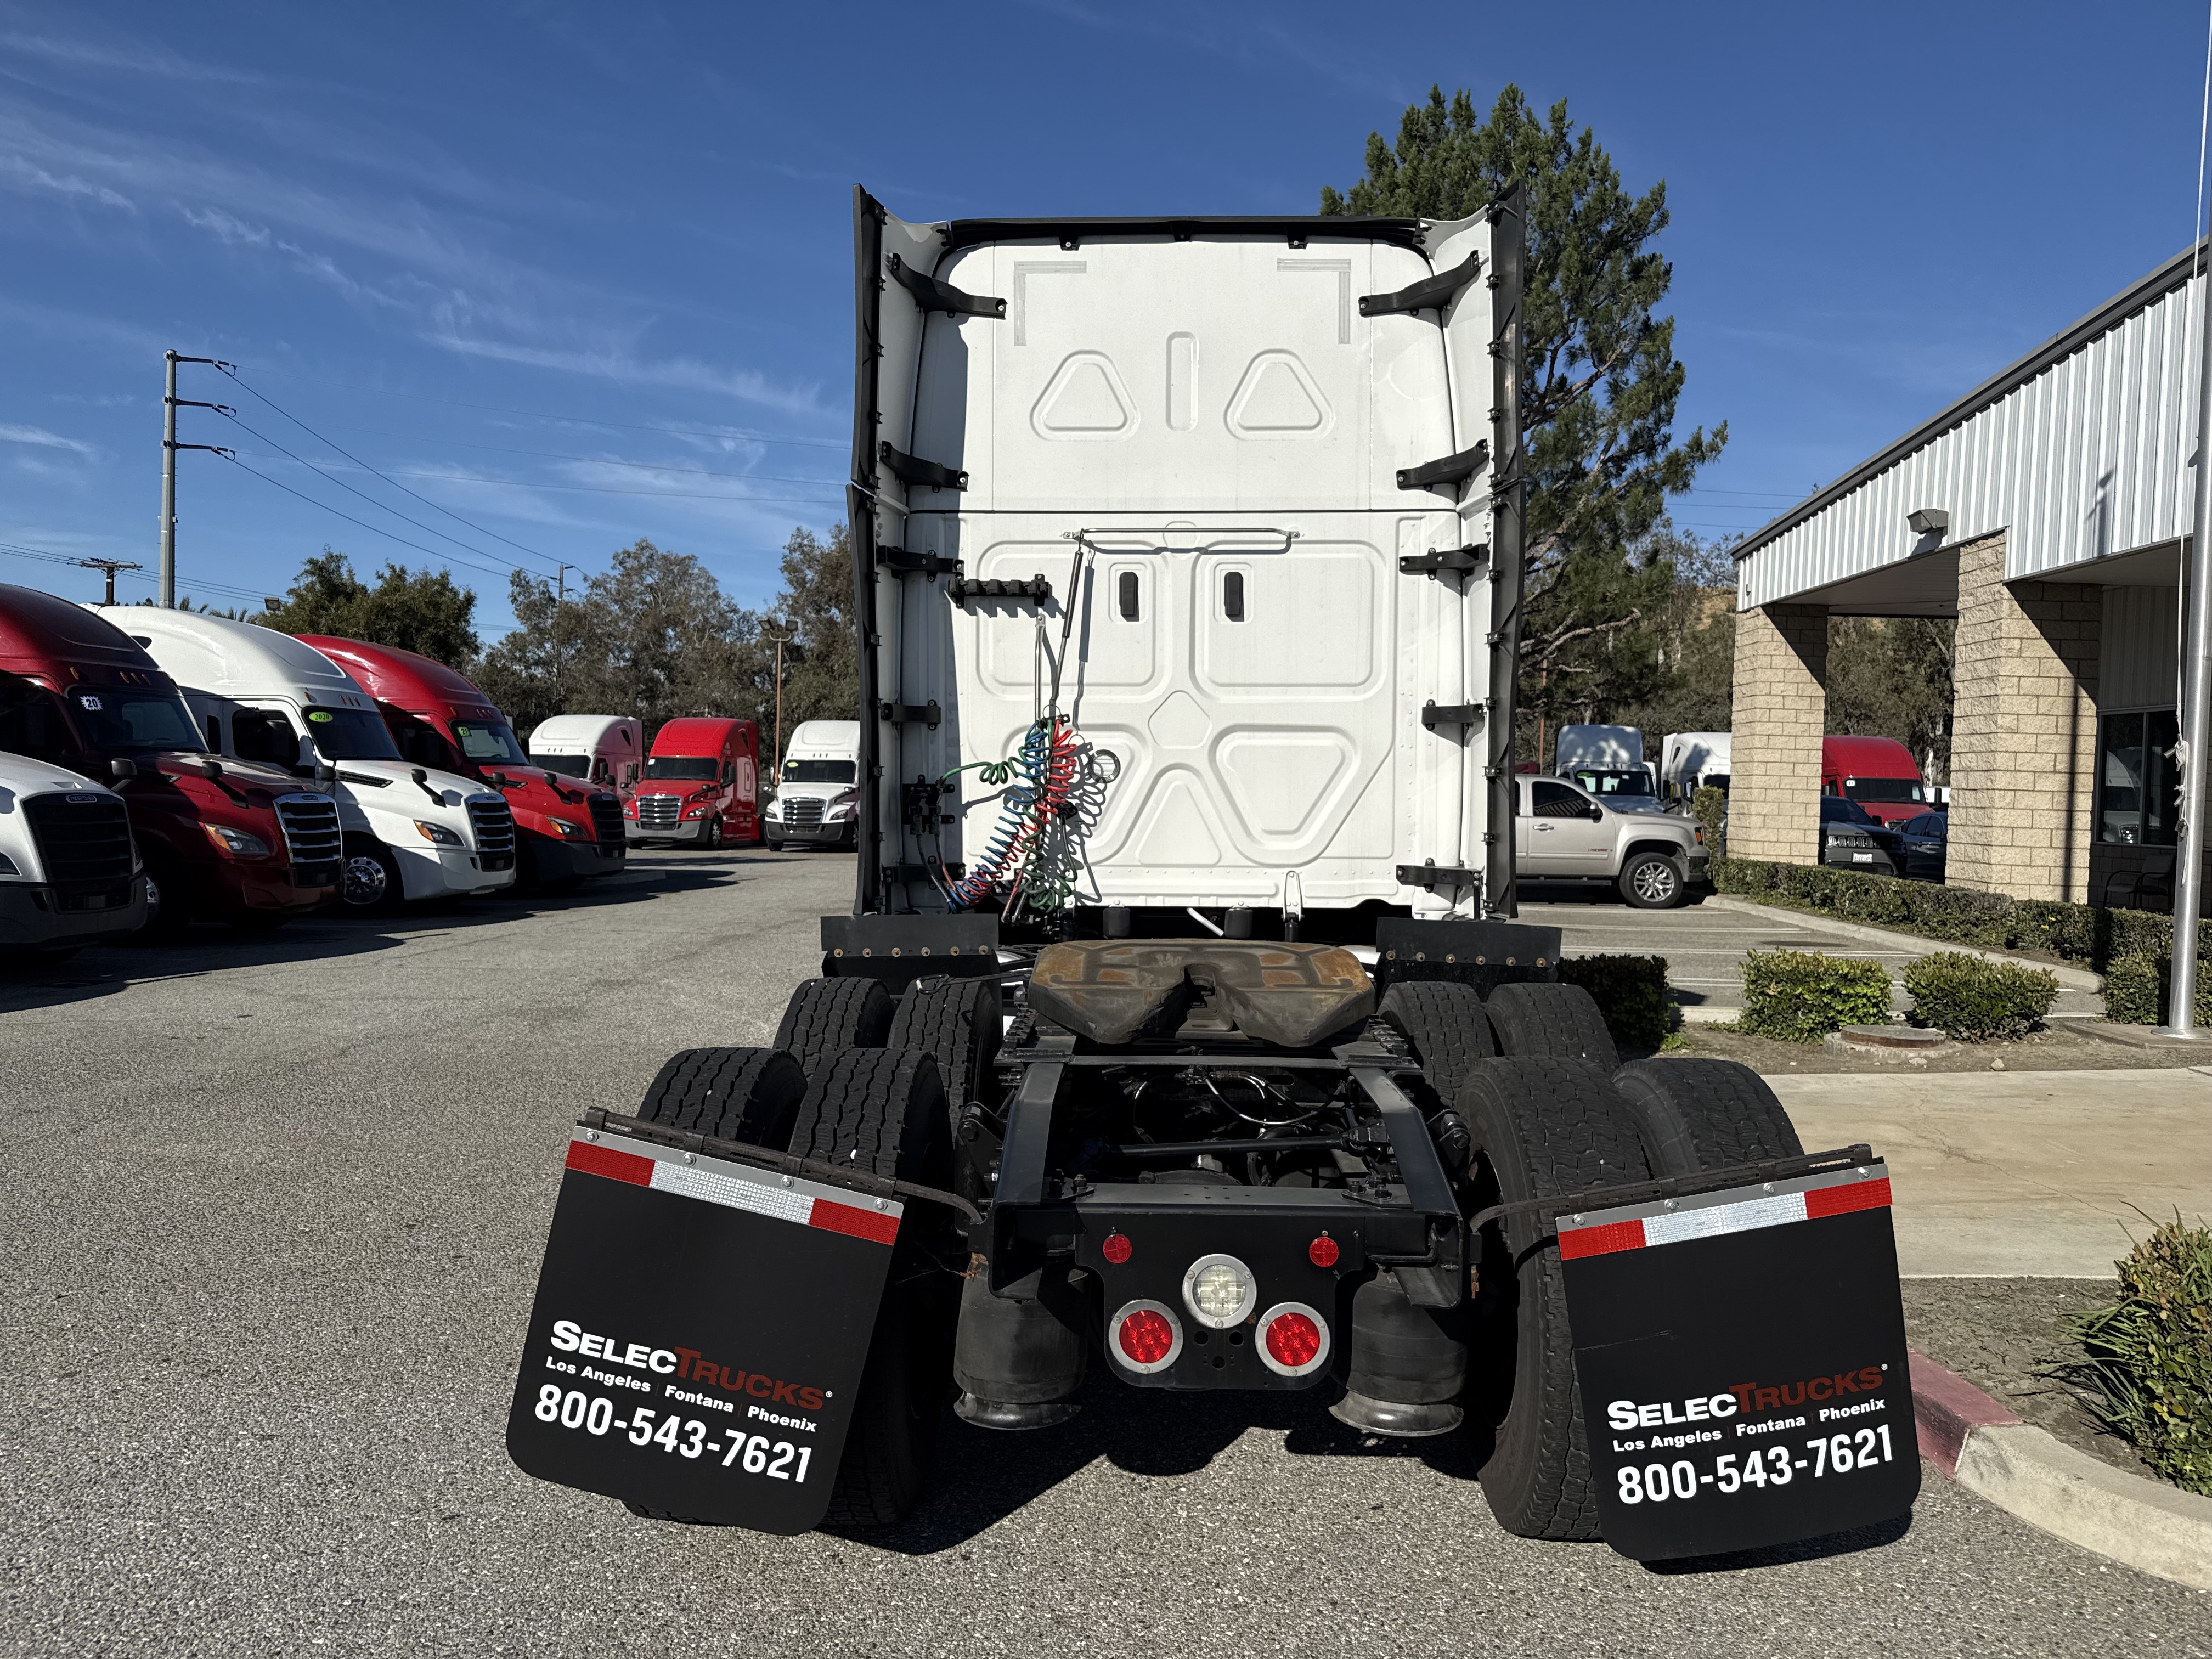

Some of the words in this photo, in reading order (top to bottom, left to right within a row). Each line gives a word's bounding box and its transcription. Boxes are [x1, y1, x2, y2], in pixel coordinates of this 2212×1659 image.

[86, 698, 98, 708] 20
[546, 1356, 577, 1374] Los
[580, 1366, 651, 1393] Angeles
[664, 1385, 734, 1413] Fontana
[747, 1405, 817, 1432] Phoenix
[1613, 1440, 1645, 1452] Los
[1650, 1429, 1722, 1448] Angeles
[1736, 1416, 1806, 1437] Fontana
[1819, 1398, 1886, 1422] Phoenix
[535, 1384, 814, 1483] 800-543-7621
[1617, 1424, 1893, 1504] 800-543-7621
